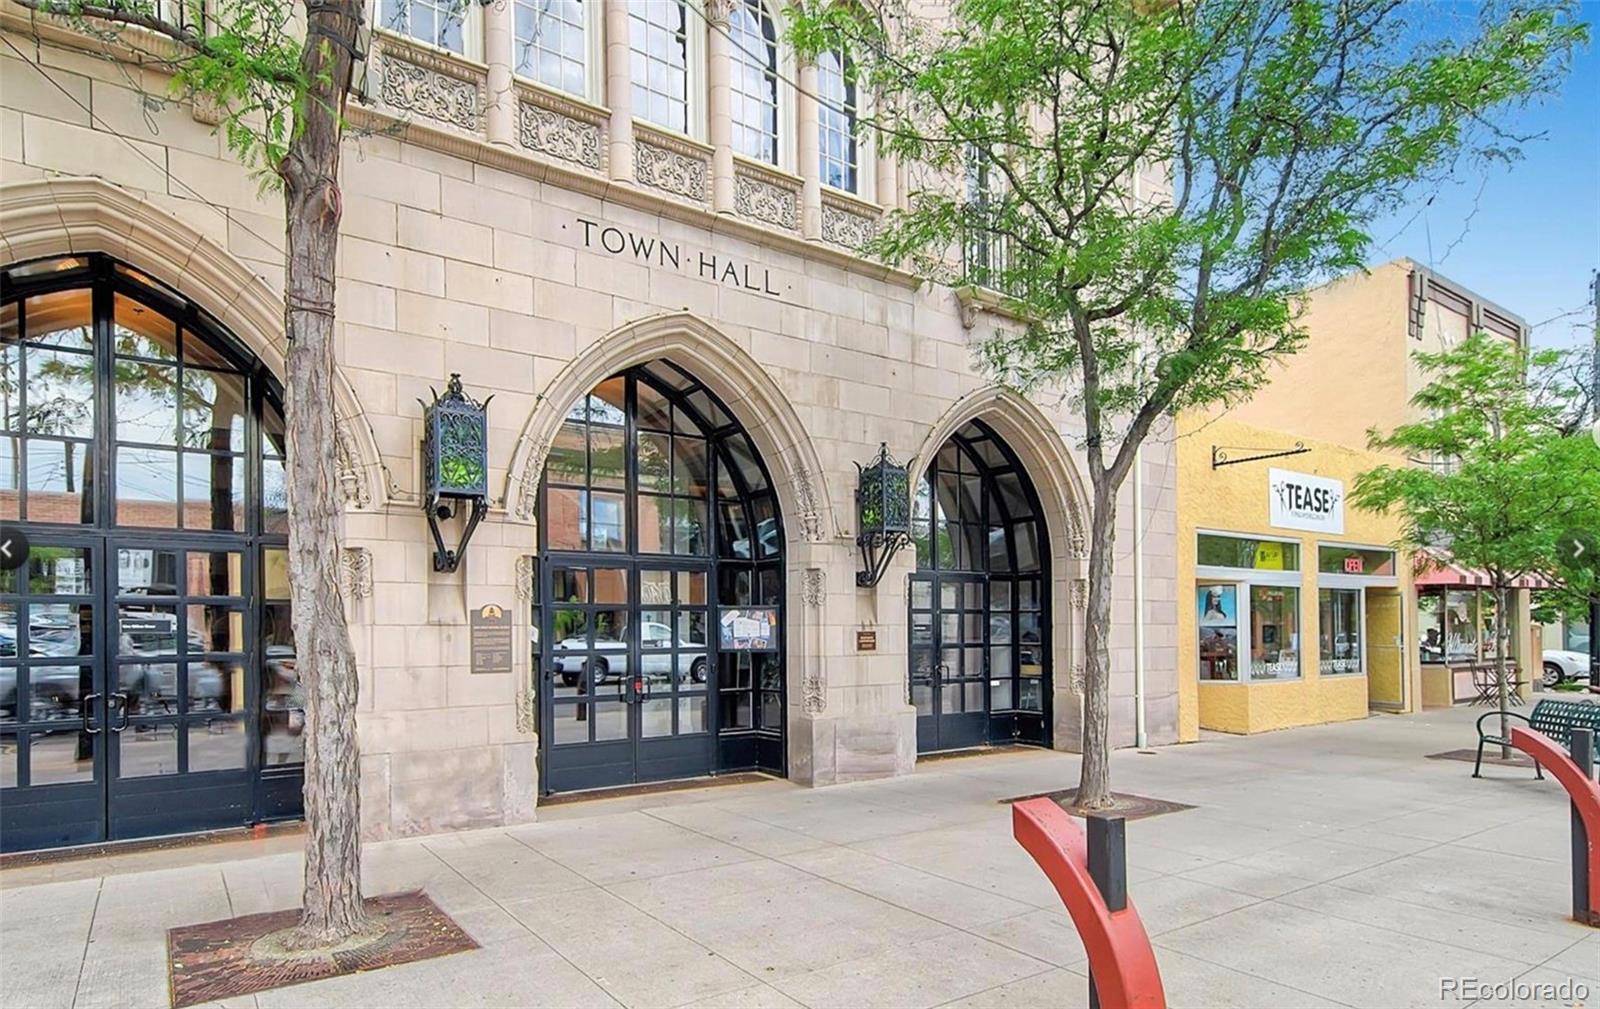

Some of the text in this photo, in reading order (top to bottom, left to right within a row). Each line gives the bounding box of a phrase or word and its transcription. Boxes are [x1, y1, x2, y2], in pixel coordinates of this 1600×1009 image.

[577, 219, 781, 296] TOWN HALL
[1285, 483, 1329, 513] TEASE
